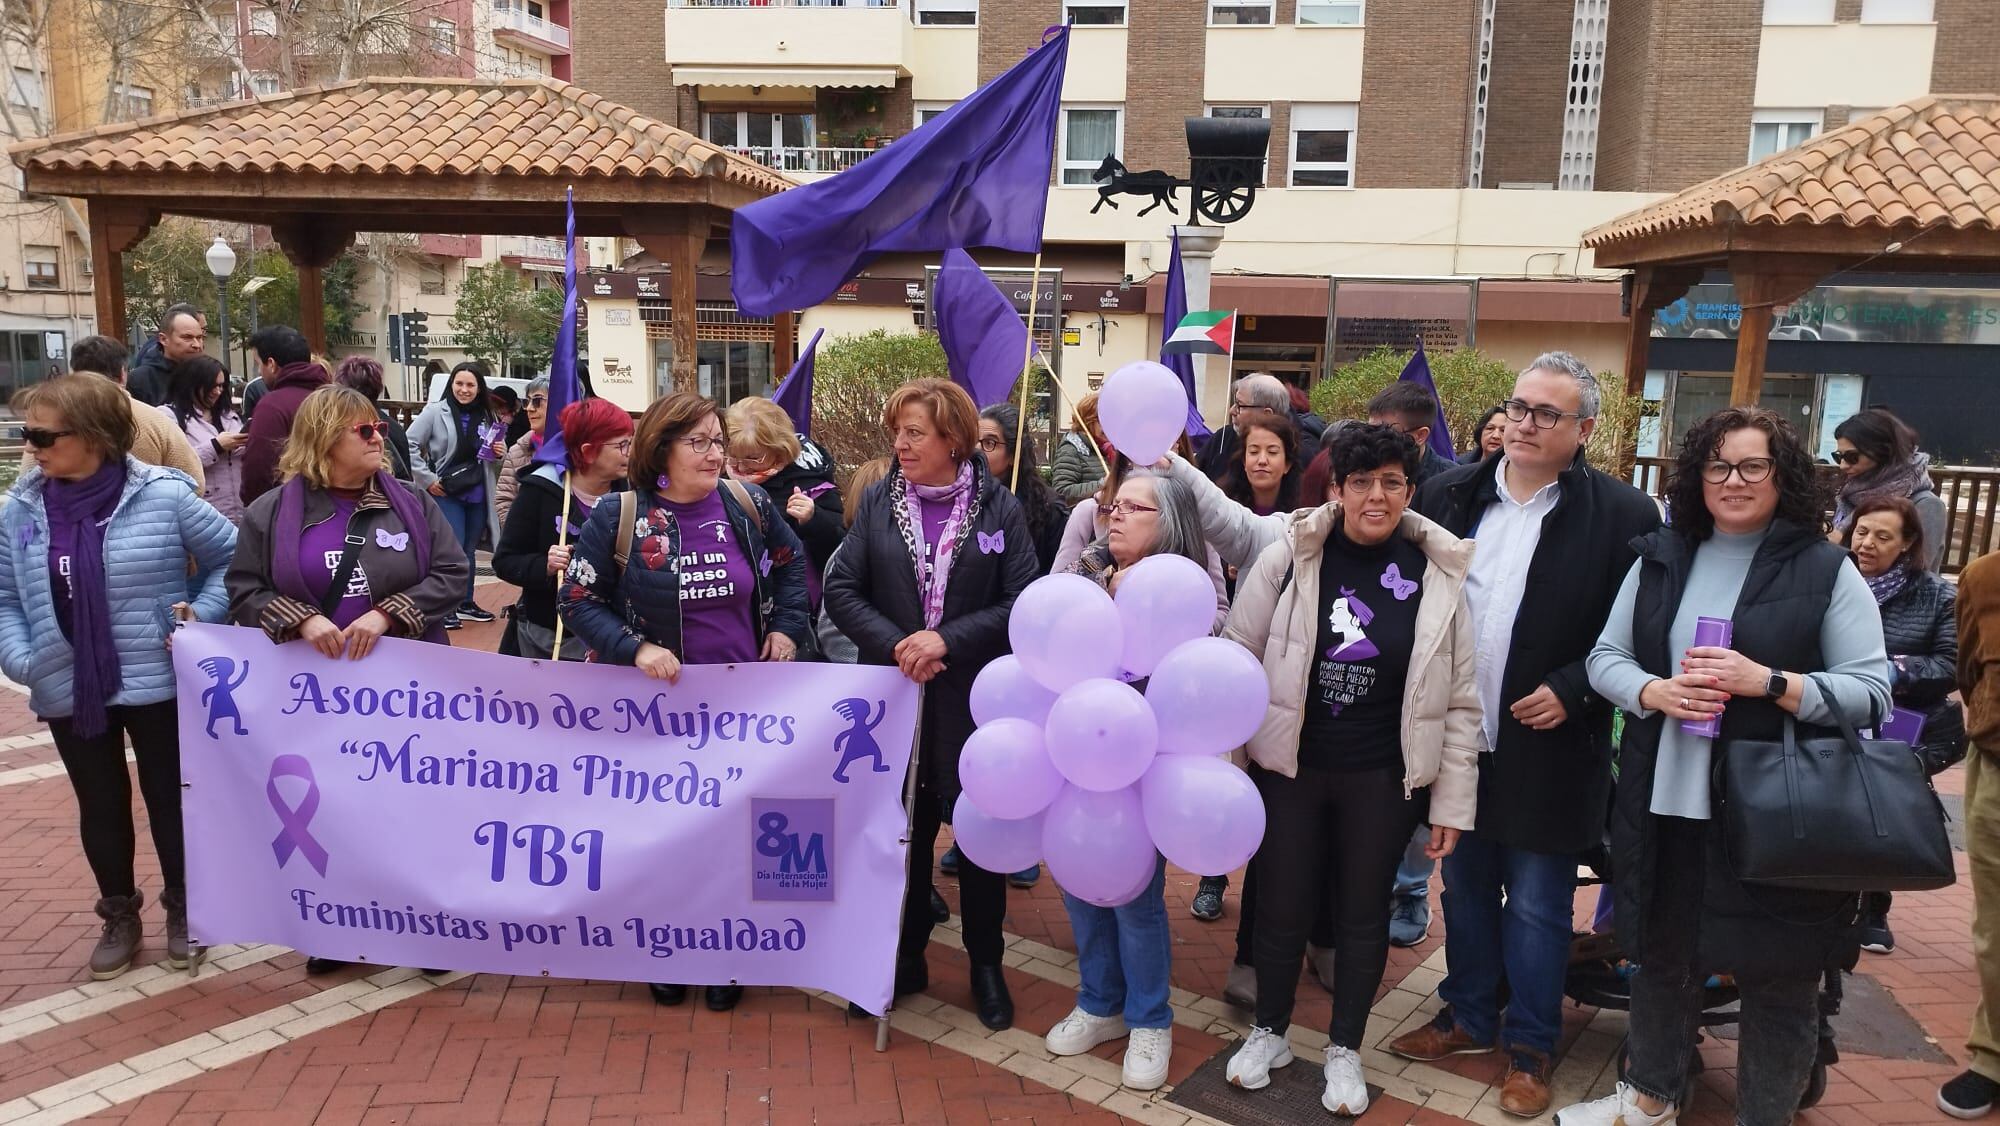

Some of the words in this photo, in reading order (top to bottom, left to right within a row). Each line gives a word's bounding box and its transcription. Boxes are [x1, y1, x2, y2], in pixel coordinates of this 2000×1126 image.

[1970, 307, 2000, 325] ES
[681, 552, 698, 566] ni
[704, 552, 727, 564] un
[681, 569, 727, 585] paso
[680, 582, 735, 600] atrás!
[1320, 660, 1346, 672] PORQUE
[1319, 670, 1344, 682] PORQUE
[1346, 673, 1368, 686] PUEDO
[1318, 679, 1344, 692] PORQUE
[1345, 683, 1356, 694] ME
[1357, 686, 1368, 696] DA
[1323, 689, 1333, 699] LA
[1335, 691, 1354, 704] GANA
[281, 672, 540, 730] Asociación
[549, 693, 604, 731] de
[613, 692, 796, 751] Mujeres
[340, 733, 560, 795] “Mariana
[573, 754, 743, 808] Pineda”
[756, 811, 828, 873] 8M
[474, 821, 604, 891] IBI
[772, 871, 828, 881] Internacional
[780, 880, 790, 888] de
[792, 880, 800, 888] la
[802, 880, 828, 890] Mujer
[291, 888, 489, 941] Feministas
[498, 918, 566, 951] por
[576, 916, 615, 948] la
[624, 917, 807, 958] Igualdad
